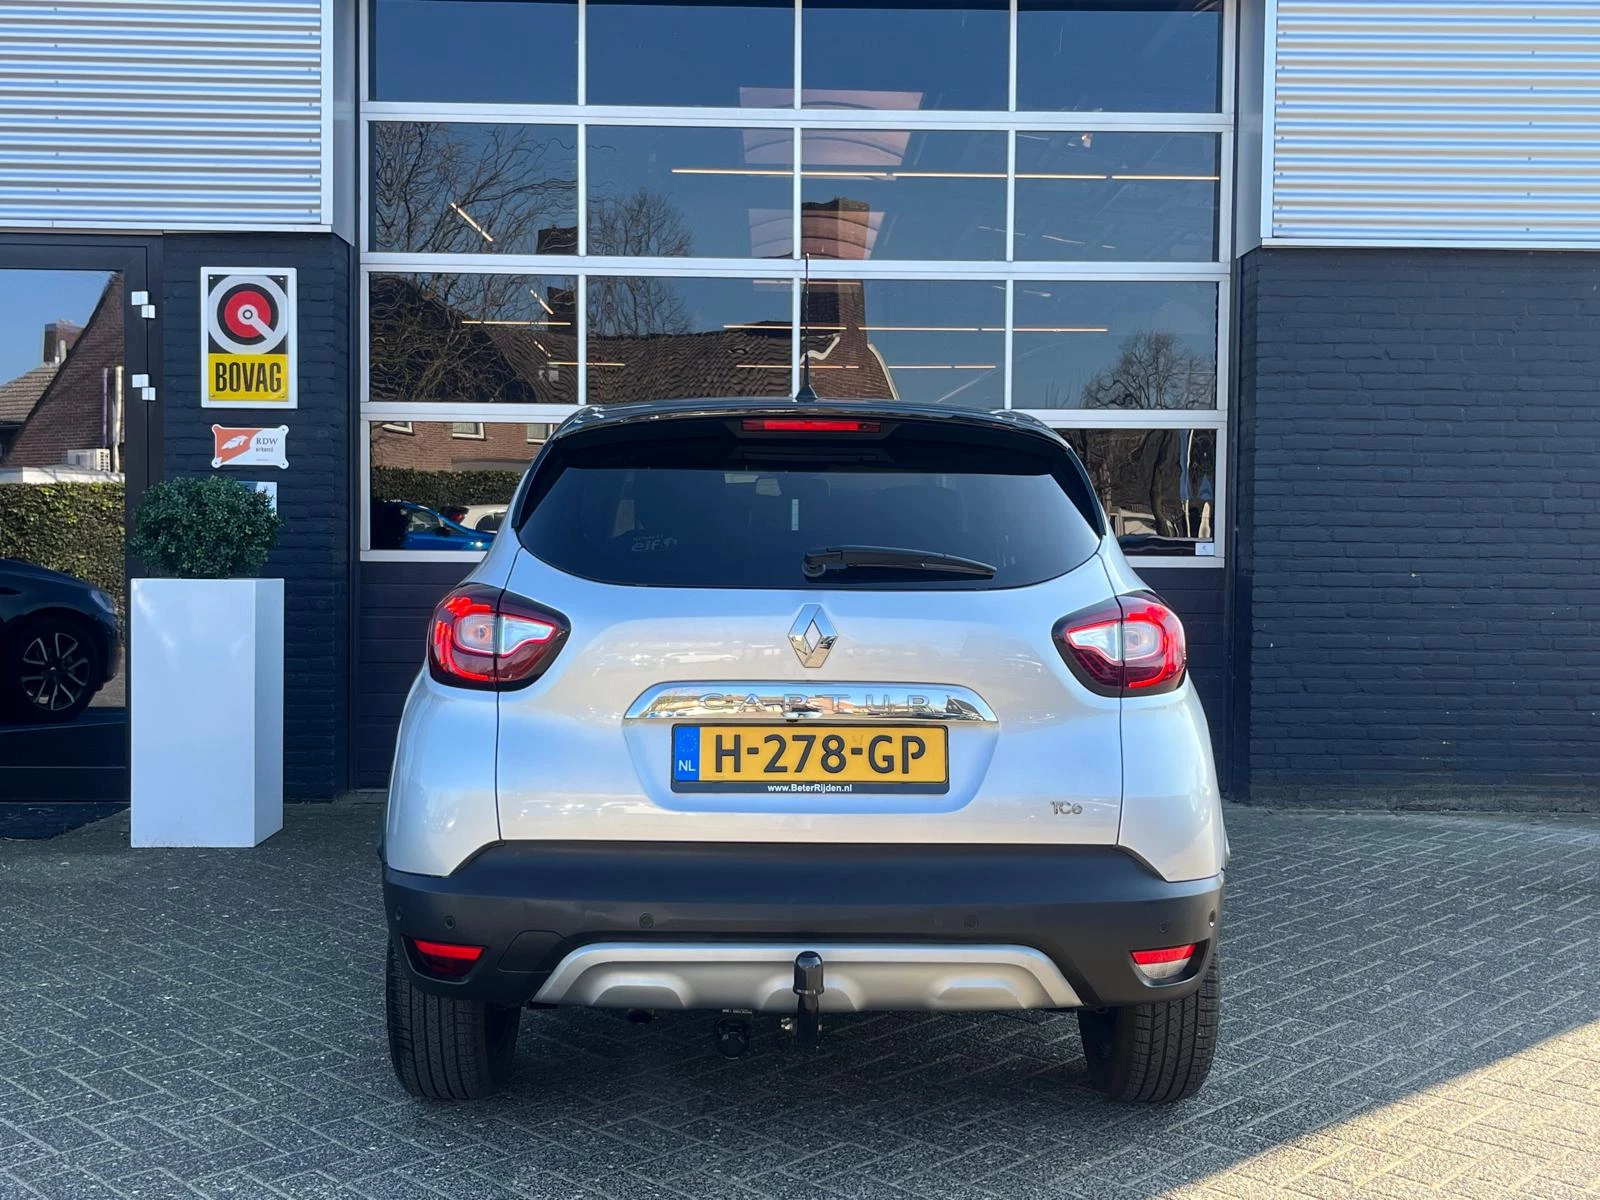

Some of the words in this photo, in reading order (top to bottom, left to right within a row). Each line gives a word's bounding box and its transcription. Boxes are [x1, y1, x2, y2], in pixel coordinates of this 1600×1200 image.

[215, 362, 282, 392] BOVAG
[256, 437, 278, 445] RDW
[698, 693, 930, 713] CAPTUR
[715, 734, 926, 774] H-278-GP
[678, 760, 696, 771] NL
[767, 784, 853, 794] www.BeterRijden.nl
